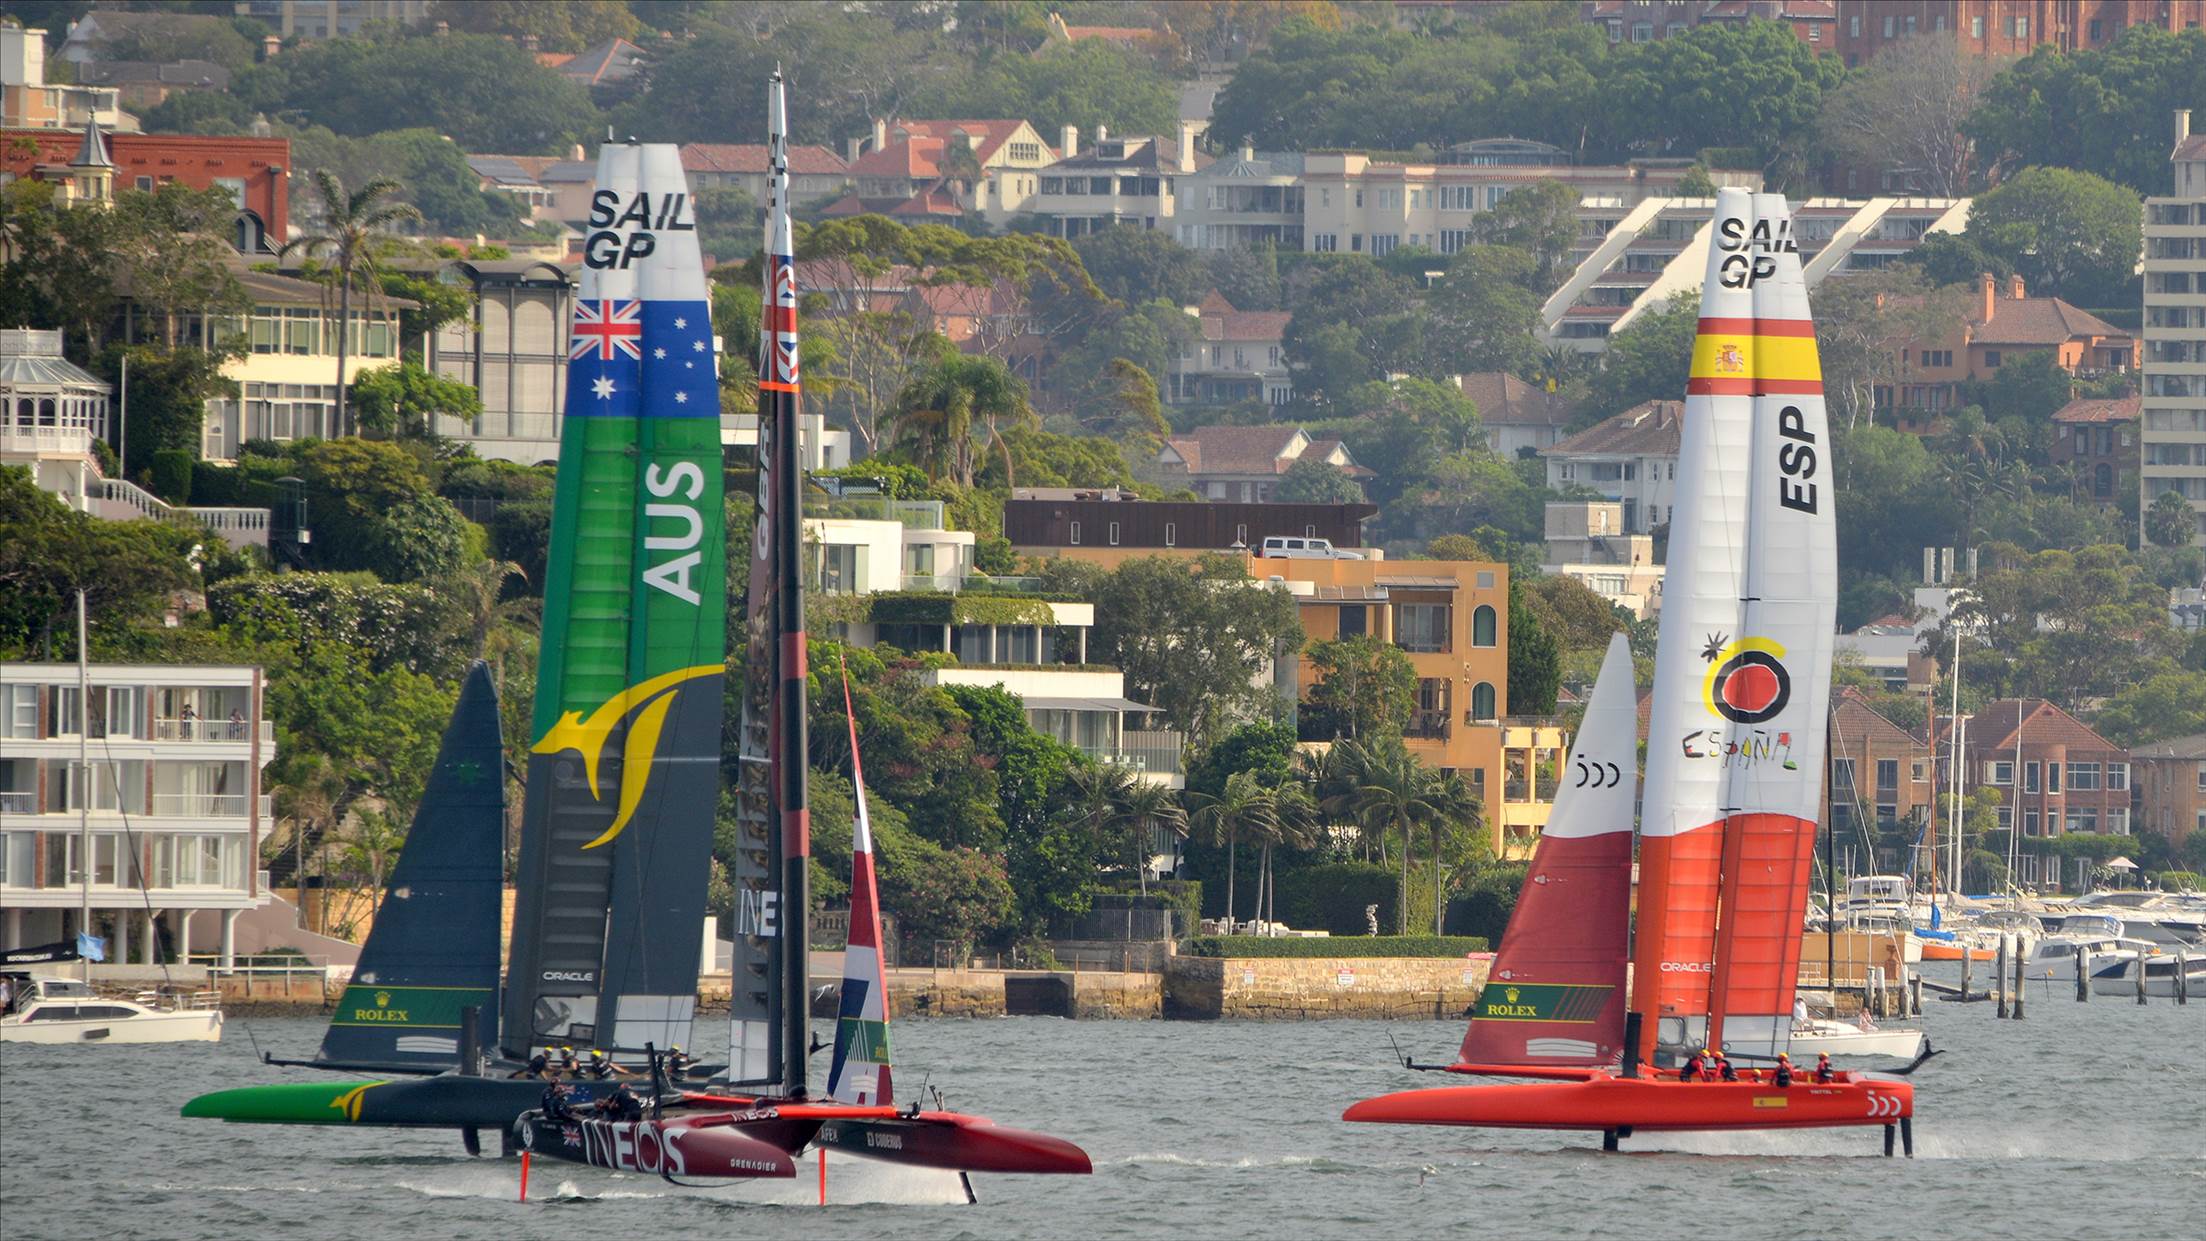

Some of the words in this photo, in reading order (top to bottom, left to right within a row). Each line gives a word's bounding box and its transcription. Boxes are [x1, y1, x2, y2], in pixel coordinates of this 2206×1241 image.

[588, 190, 694, 230] SAIL
[584, 231, 656, 269] GP
[1719, 255, 1776, 289] GP
[1779, 406, 1817, 515] ESP
[642, 461, 705, 606] AUS
[1682, 730, 1798, 771] ESPAÑA
[543, 971, 593, 982] ORACLE
[1660, 962, 1711, 973] ORACLE
[355, 1009, 408, 1022] ROLEX
[1487, 1005, 1537, 1017] ROLEX
[731, 1107, 779, 1122] INEOS
[581, 1118, 688, 1175] INEOS
[730, 1158, 777, 1172] GRENADIER
